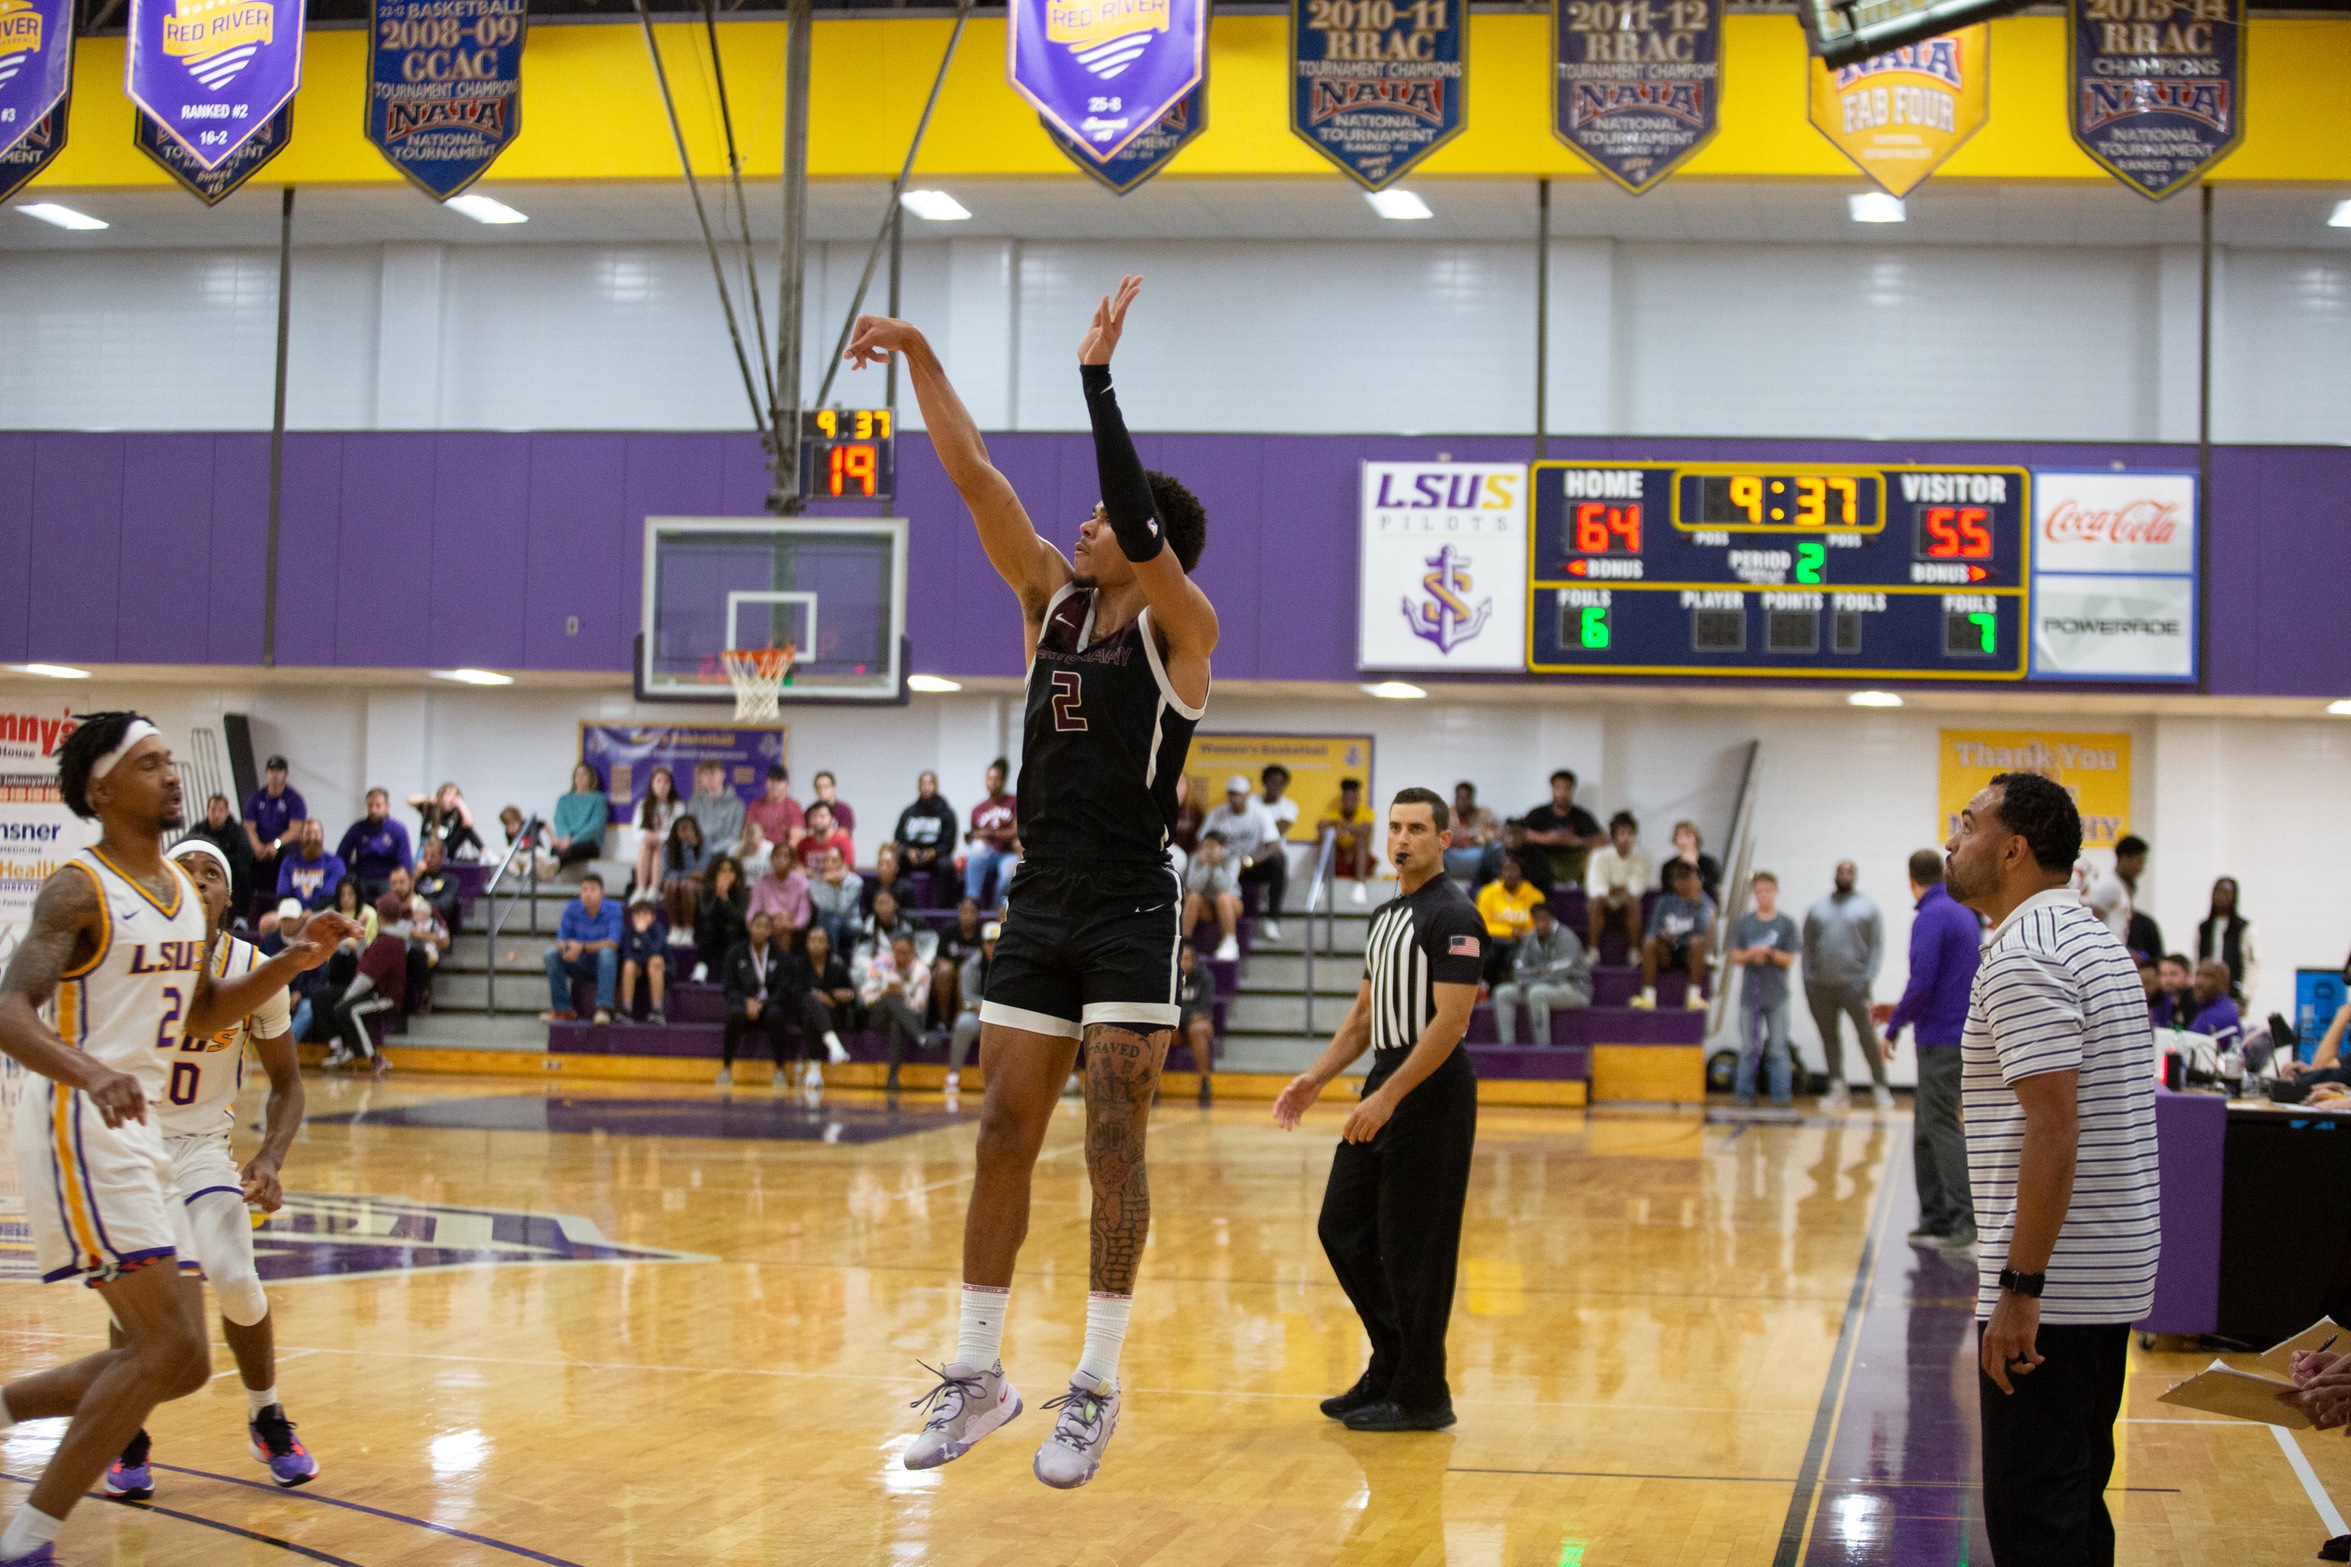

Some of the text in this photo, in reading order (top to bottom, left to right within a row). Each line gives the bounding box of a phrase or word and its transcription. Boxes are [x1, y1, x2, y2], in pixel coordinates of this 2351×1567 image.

[408, 1, 524, 19] BASKETBALL
[1053, 0, 1163, 28] RED RIVER
[1309, 0, 1448, 30] 2010-11
[1567, 2, 1707, 31] 2011-12
[166, 22, 205, 42] RED
[211, 9, 269, 36] RIVER
[380, 16, 518, 50] 2008-09
[1325, 30, 1435, 61] RRAC
[1585, 32, 1694, 62] RRAC
[2103, 22, 2213, 54] RRAC
[1299, 61, 1462, 77] TOURNAMENT CHAMPIONS
[1558, 63, 1718, 79] TOURNAMENT CHAMPIONS
[2092, 58, 2222, 75] CHAMPIONS
[375, 82, 451, 99] TOURNAMENT
[1317, 79, 1440, 119] NAIA
[1578, 83, 1697, 118] NAIA
[181, 104, 248, 119] RANKED #2
[1844, 85, 1956, 134] FAB FOUR
[2090, 83, 2222, 124] NAIA
[389, 100, 502, 136] NAIA
[1332, 114, 1420, 127] NATIONAL
[1594, 117, 1680, 131] NATIONAL
[200, 130, 228, 146] 16-2
[407, 132, 486, 147] NATIONAL
[1320, 127, 1436, 142] TOURNAMENT
[1581, 131, 1696, 145] TOURNAMENT
[2111, 128, 2199, 142] NATIONAL
[393, 143, 497, 161] TOURNAMENT
[2099, 143, 2216, 157] TOURNAMENT
[829, 445, 877, 497] 19
[1376, 474, 1519, 509] LSUS
[1564, 470, 1644, 498] HOME
[1902, 474, 2006, 503] VISITOR
[1729, 475, 1857, 526] 9:37
[1380, 516, 1508, 530] PILOTS
[1577, 502, 1641, 553] 64
[1927, 507, 1991, 558] 55
[1692, 531, 1730, 546] POSS
[1825, 533, 1862, 548] POSS
[1586, 559, 1643, 579] BONUS
[1728, 550, 1791, 570] PERIOD
[1796, 542, 1825, 584] 2
[1911, 563, 1969, 583] BONUS
[1557, 590, 1612, 608] FOULS
[1680, 591, 1744, 609] PLAYER
[1761, 592, 1823, 611] POINTS
[1831, 592, 1887, 612] FOULS
[1943, 593, 1997, 613] FOULS
[1581, 607, 1609, 649] 6
[1968, 612, 1995, 654] 7
[2044, 618, 2180, 636] POWERADE
[1052, 670, 1088, 731] 2
[1955, 740, 2117, 769] Thank You
[156, 986, 181, 1048] 2
